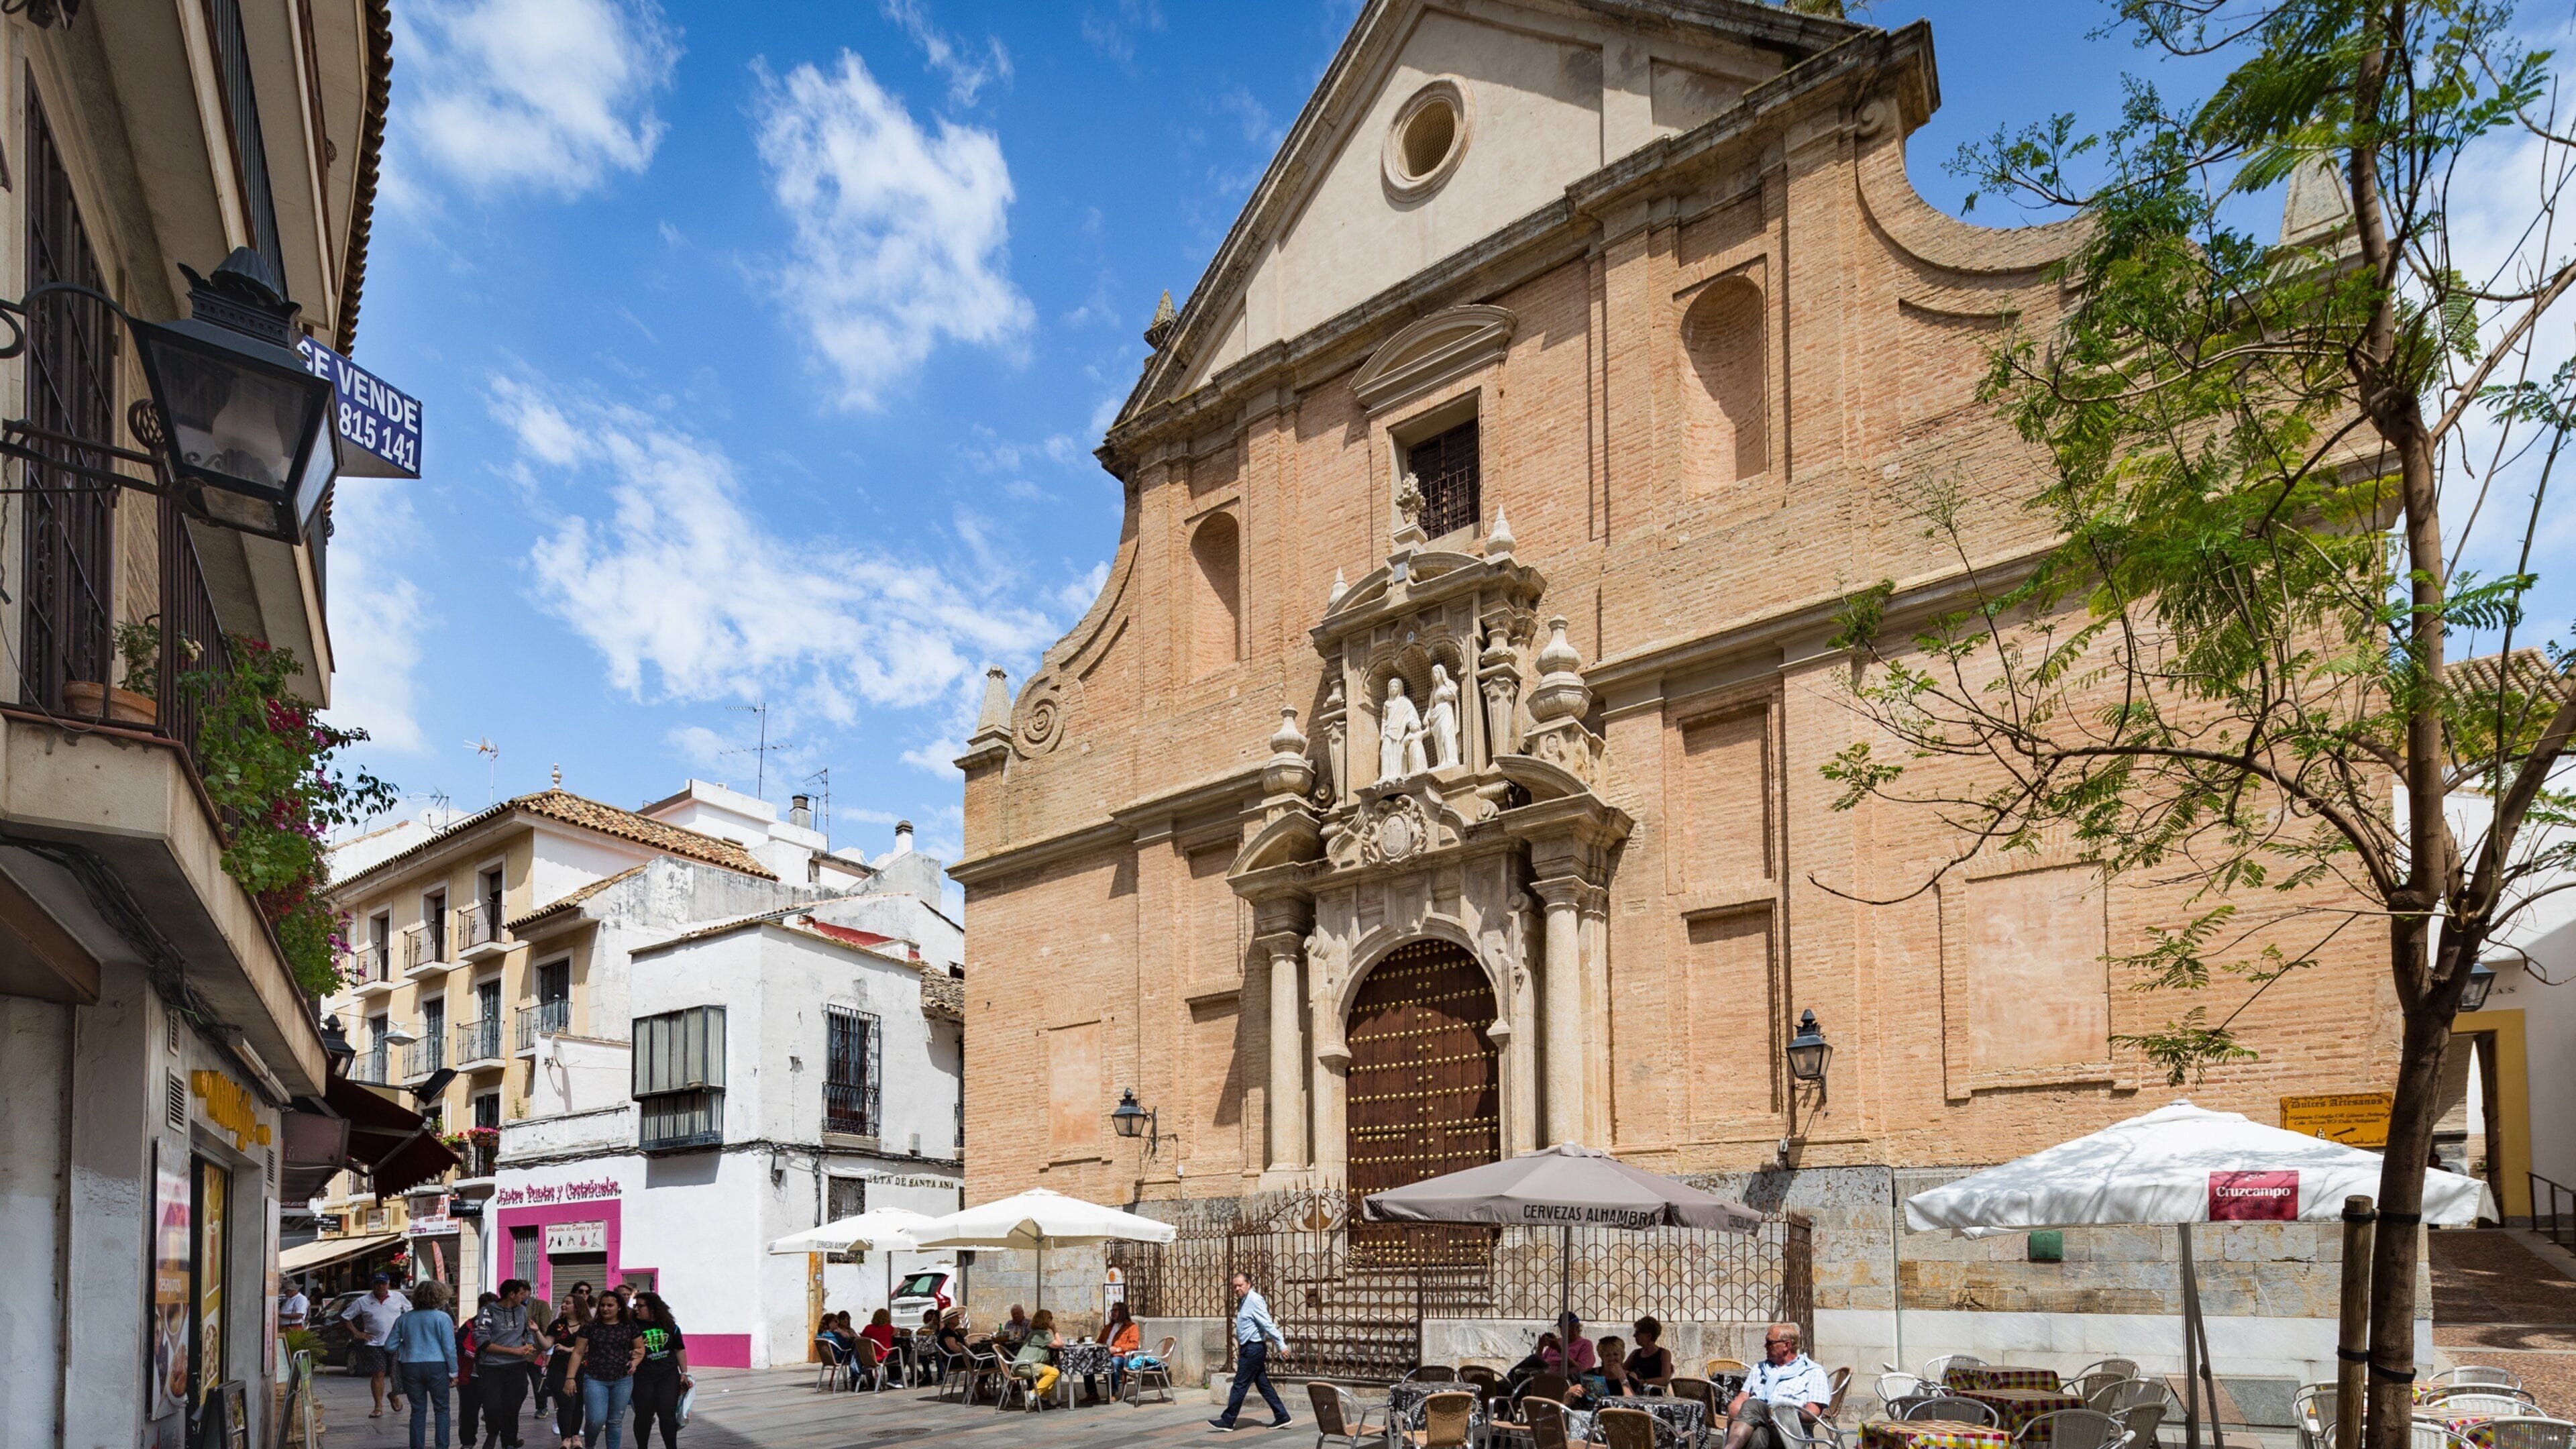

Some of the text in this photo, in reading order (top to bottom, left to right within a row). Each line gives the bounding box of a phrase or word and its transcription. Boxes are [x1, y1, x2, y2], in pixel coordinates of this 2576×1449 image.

[337, 360, 418, 434] VENDE
[339, 402, 417, 472] 815 141
[2291, 1098, 2383, 1108] Dulces Artesanos
[867, 1175, 954, 1189] ALTA DE SANTA ANA
[557, 1185, 563, 1203] y
[2216, 1186, 2291, 1198] Cruzcampo
[423, 1205, 445, 1216] GUIADAS
[1523, 1204, 1657, 1227] CERVEZAS ALHAMBRA
